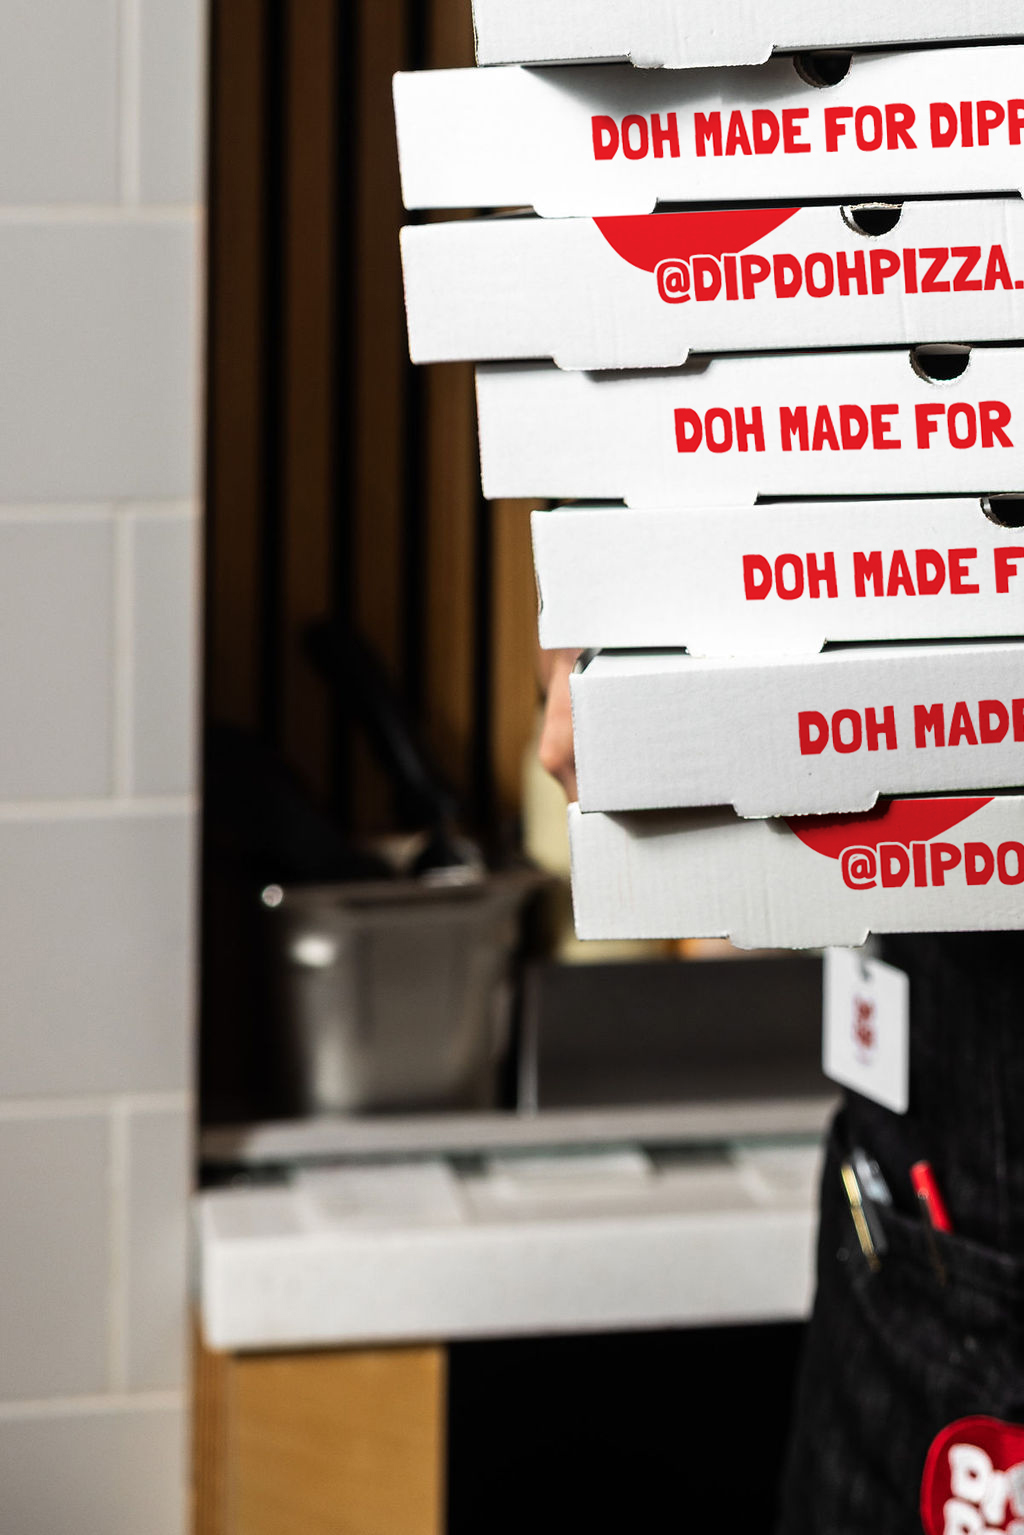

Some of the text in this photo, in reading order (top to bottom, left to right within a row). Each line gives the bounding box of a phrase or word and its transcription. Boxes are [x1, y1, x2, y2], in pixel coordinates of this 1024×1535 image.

[590, 112, 681, 161] DOH
[693, 107, 812, 158] MADE
[823, 103, 918, 153] FOR
[673, 405, 766, 454] DOH
[778, 403, 902, 452] MADE
[914, 400, 1015, 450] FOR
[741, 551, 839, 601] DOH
[852, 547, 980, 598] MADE
[797, 705, 898, 756] DOH
